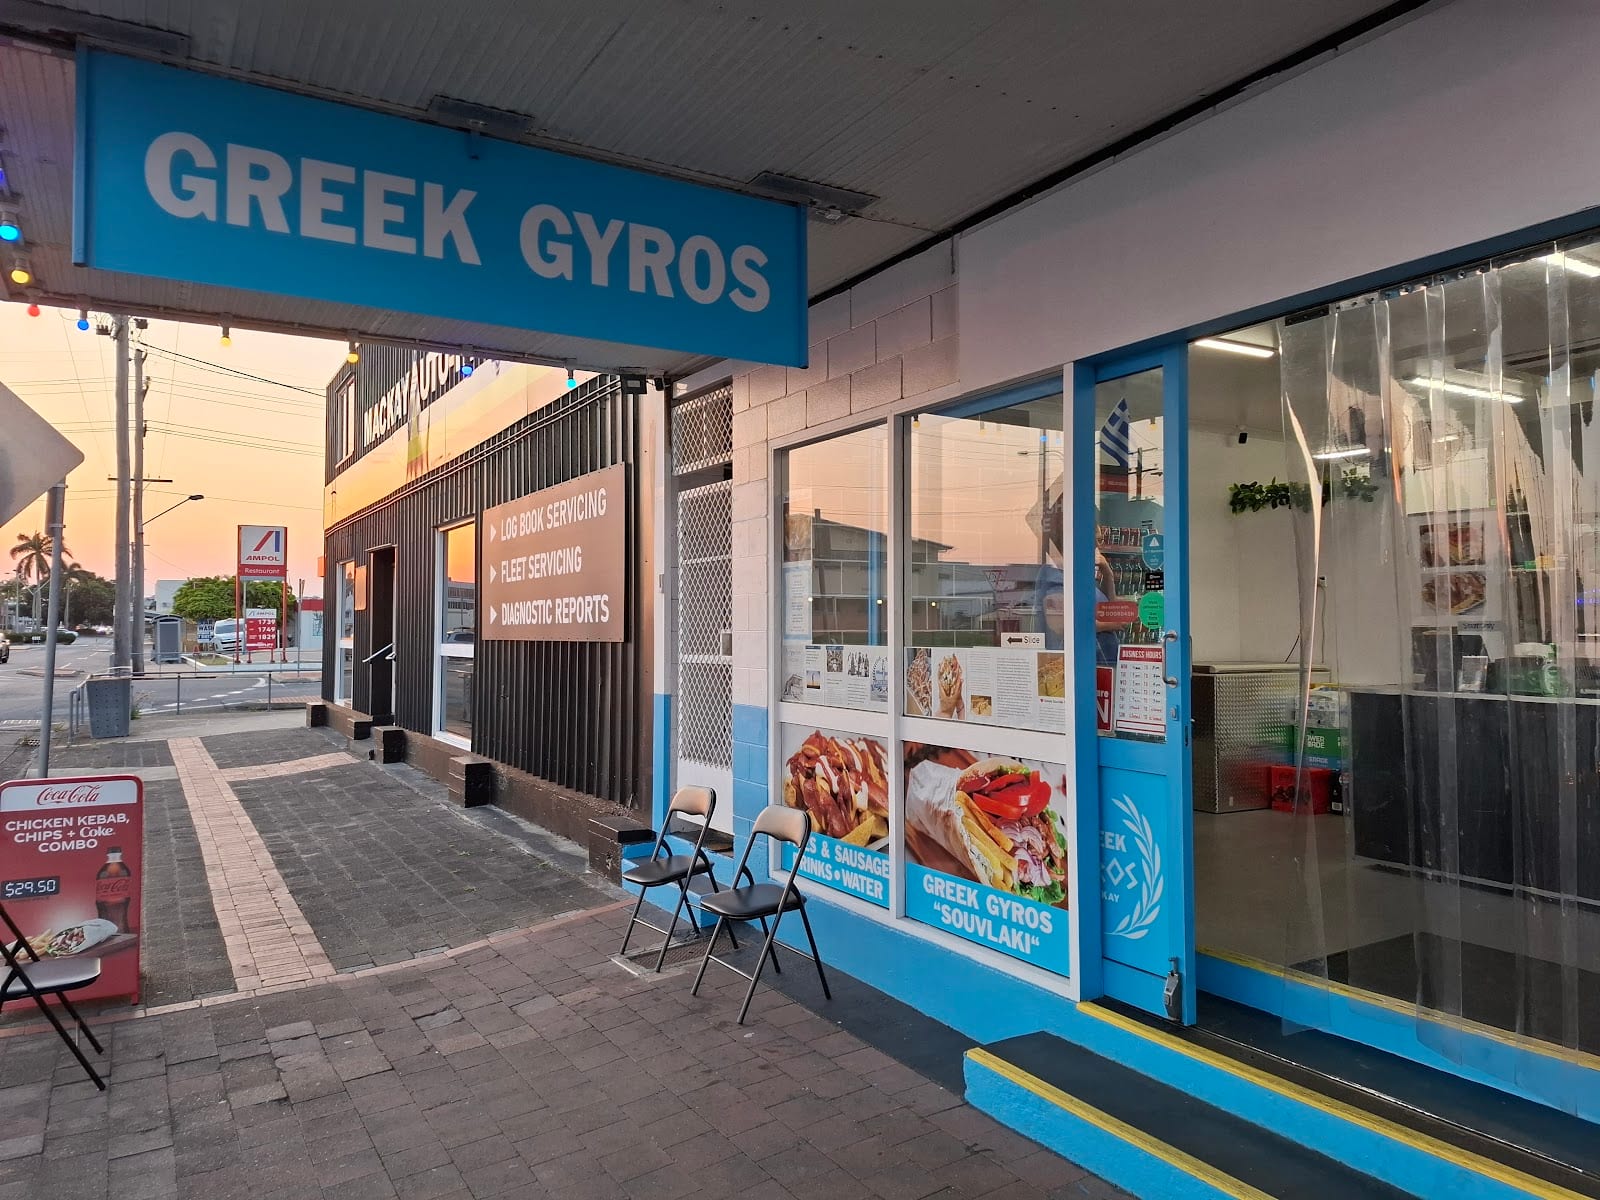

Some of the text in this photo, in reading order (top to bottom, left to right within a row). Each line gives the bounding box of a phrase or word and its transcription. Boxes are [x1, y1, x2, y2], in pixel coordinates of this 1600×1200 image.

[143, 130, 771, 313] GREEK GYROS
[364, 370, 411, 448] MACKAY
[500, 487, 607, 541] LOG BOOK SERVICING
[501, 545, 582, 583] FLEET SERVICING
[501, 594, 610, 626] DIAGNOSTIC REPORTS
[1023, 636, 1040, 644] Slice
[1122, 650, 1162, 659] BUSINESS HOURS
[36, 784, 103, 806] Coca-Cola
[5, 812, 130, 832] CHICKEN KEBAB,
[14, 826, 114, 843] CHIPS + Coke
[38, 839, 98, 853] COMBO
[821, 841, 830, 859] &
[834, 845, 889, 878] SAUSAGE
[5, 879, 57, 897] $29.50
[842, 868, 883, 900] WATER
[1101, 857, 1138, 890] OS
[923, 874, 1053, 934] GREEK GYROS
